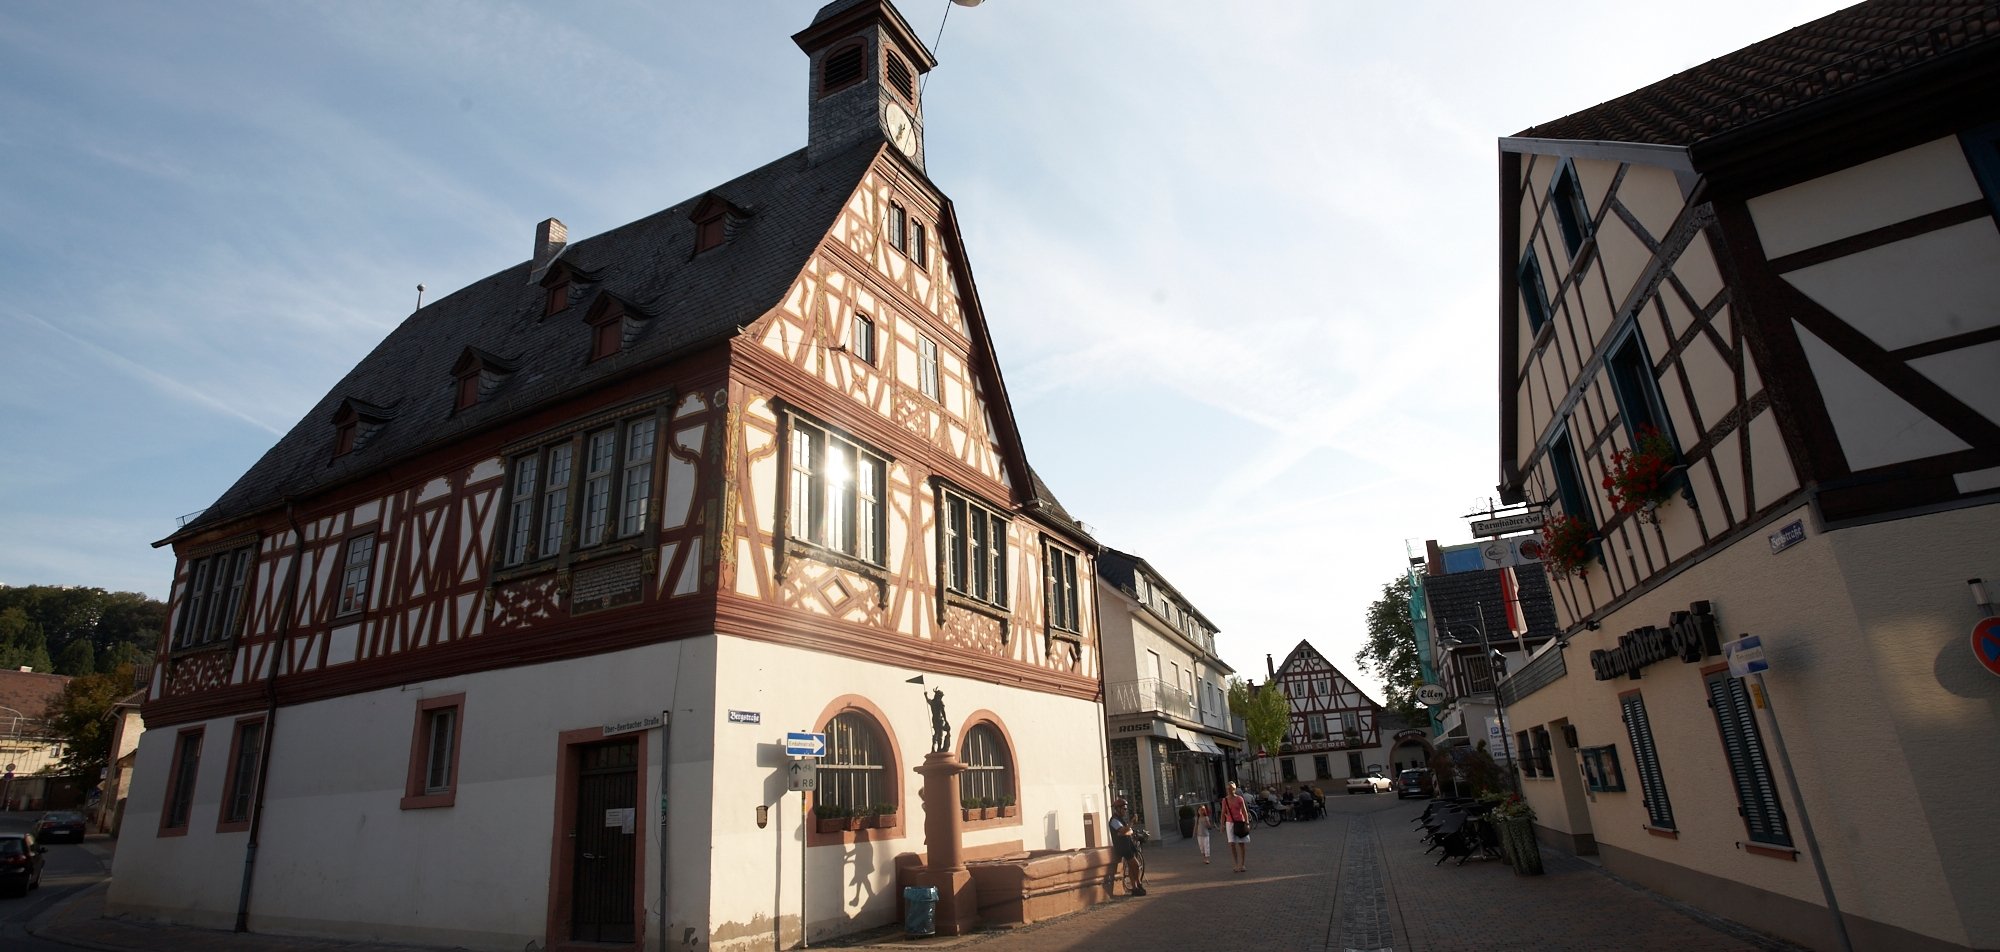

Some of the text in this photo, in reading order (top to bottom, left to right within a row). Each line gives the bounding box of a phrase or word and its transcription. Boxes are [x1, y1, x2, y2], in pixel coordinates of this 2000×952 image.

[1525, 515, 1540, 524] Hof
[1420, 689, 1443, 698] Ellen
[643, 717, 660, 727] Straße
[1119, 723, 1150, 733] ROSS
[802, 778, 814, 787] R8
